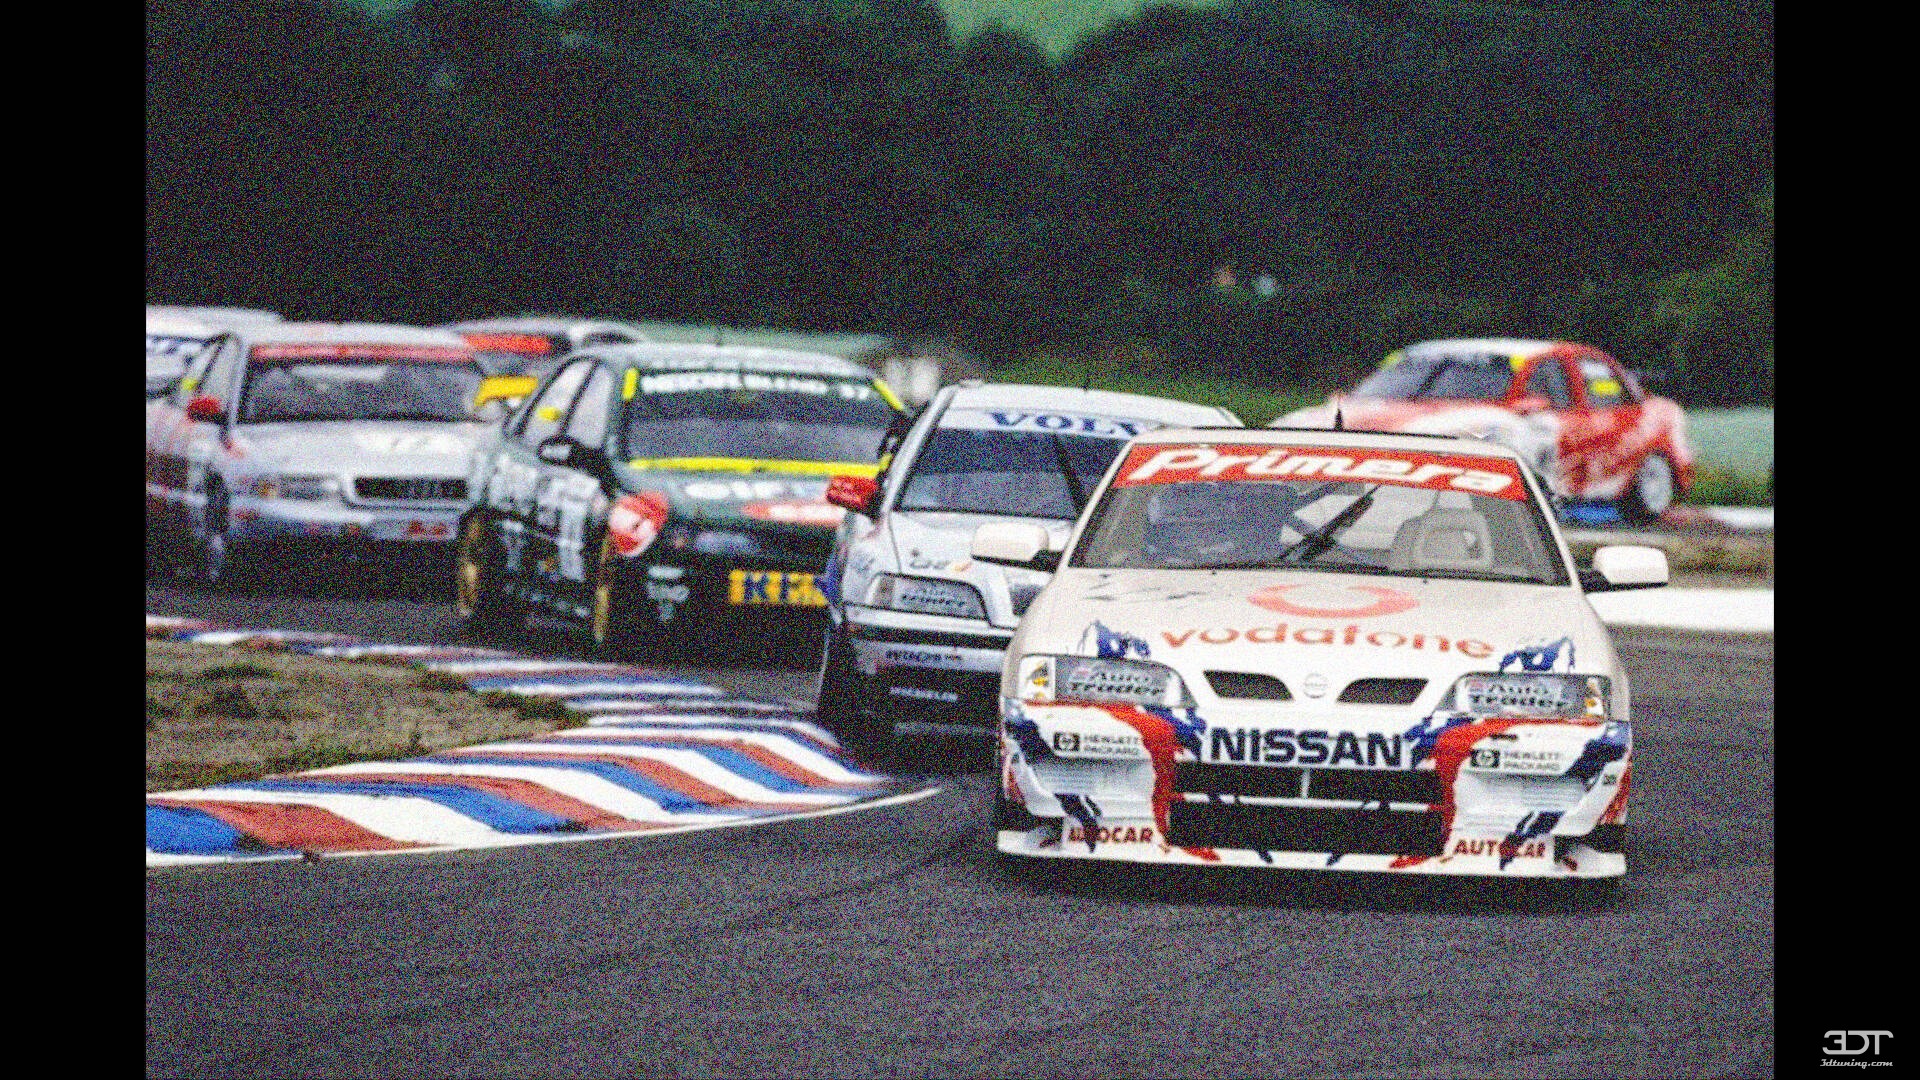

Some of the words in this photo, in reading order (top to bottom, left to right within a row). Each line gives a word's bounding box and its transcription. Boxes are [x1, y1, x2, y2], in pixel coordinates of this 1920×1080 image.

[989, 412, 1140, 437] VOLV
[1127, 448, 1513, 493] Primera
[1161, 622, 1495, 659] vodafone
[1088, 665, 1152, 683] Auto
[1487, 681, 1549, 696] Auto
[1083, 734, 1139, 745] HEWLETT
[1210, 727, 1401, 766] NISSAN
[1504, 751, 1560, 761] HEWLETT
[1503, 761, 1561, 772] PACKARD
[1068, 826, 1154, 843] AUOCAR
[1453, 840, 1546, 858] AUTCAR
